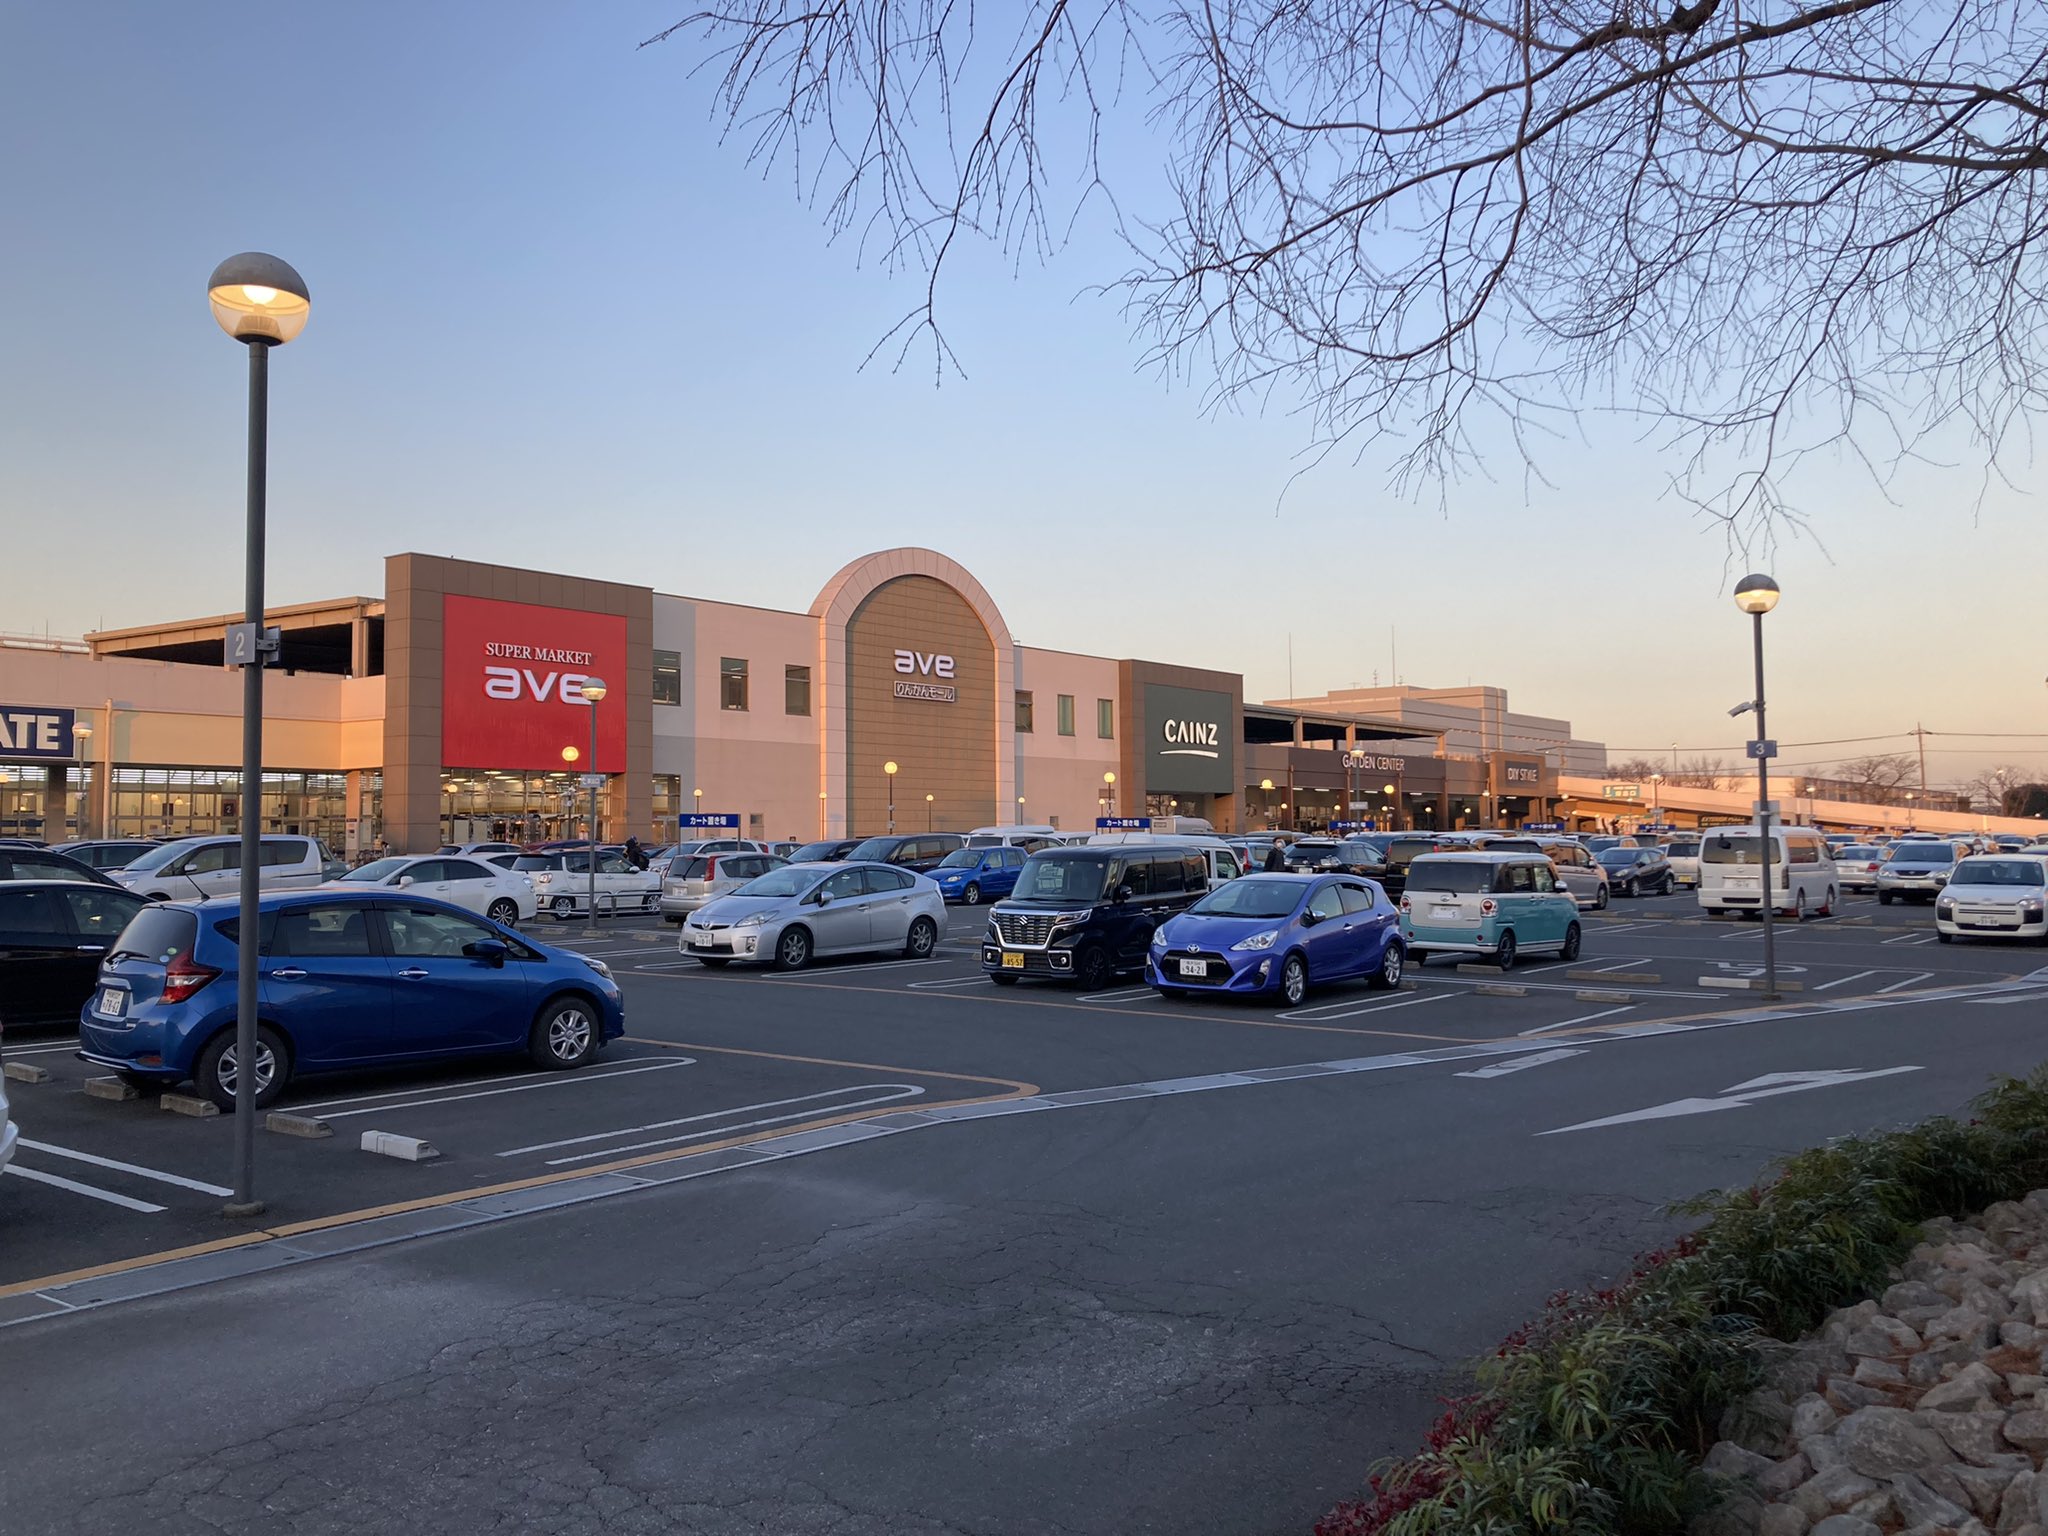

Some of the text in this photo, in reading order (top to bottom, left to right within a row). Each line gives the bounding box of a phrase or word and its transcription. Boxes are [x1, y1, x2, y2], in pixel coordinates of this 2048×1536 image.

[235, 632, 245, 657] 2
[485, 642, 592, 665] SUPER MARKET
[894, 649, 955, 678] ave
[484, 665, 592, 706] ave
[896, 683, 953, 699] りんかんモール
[1164, 718, 1218, 746] CAINZ
[1755, 743, 1765, 755] 3
[1376, 757, 1405, 771] CENTER
[1520, 768, 1537, 782] STYLE
[689, 816, 727, 826] カート置き場
